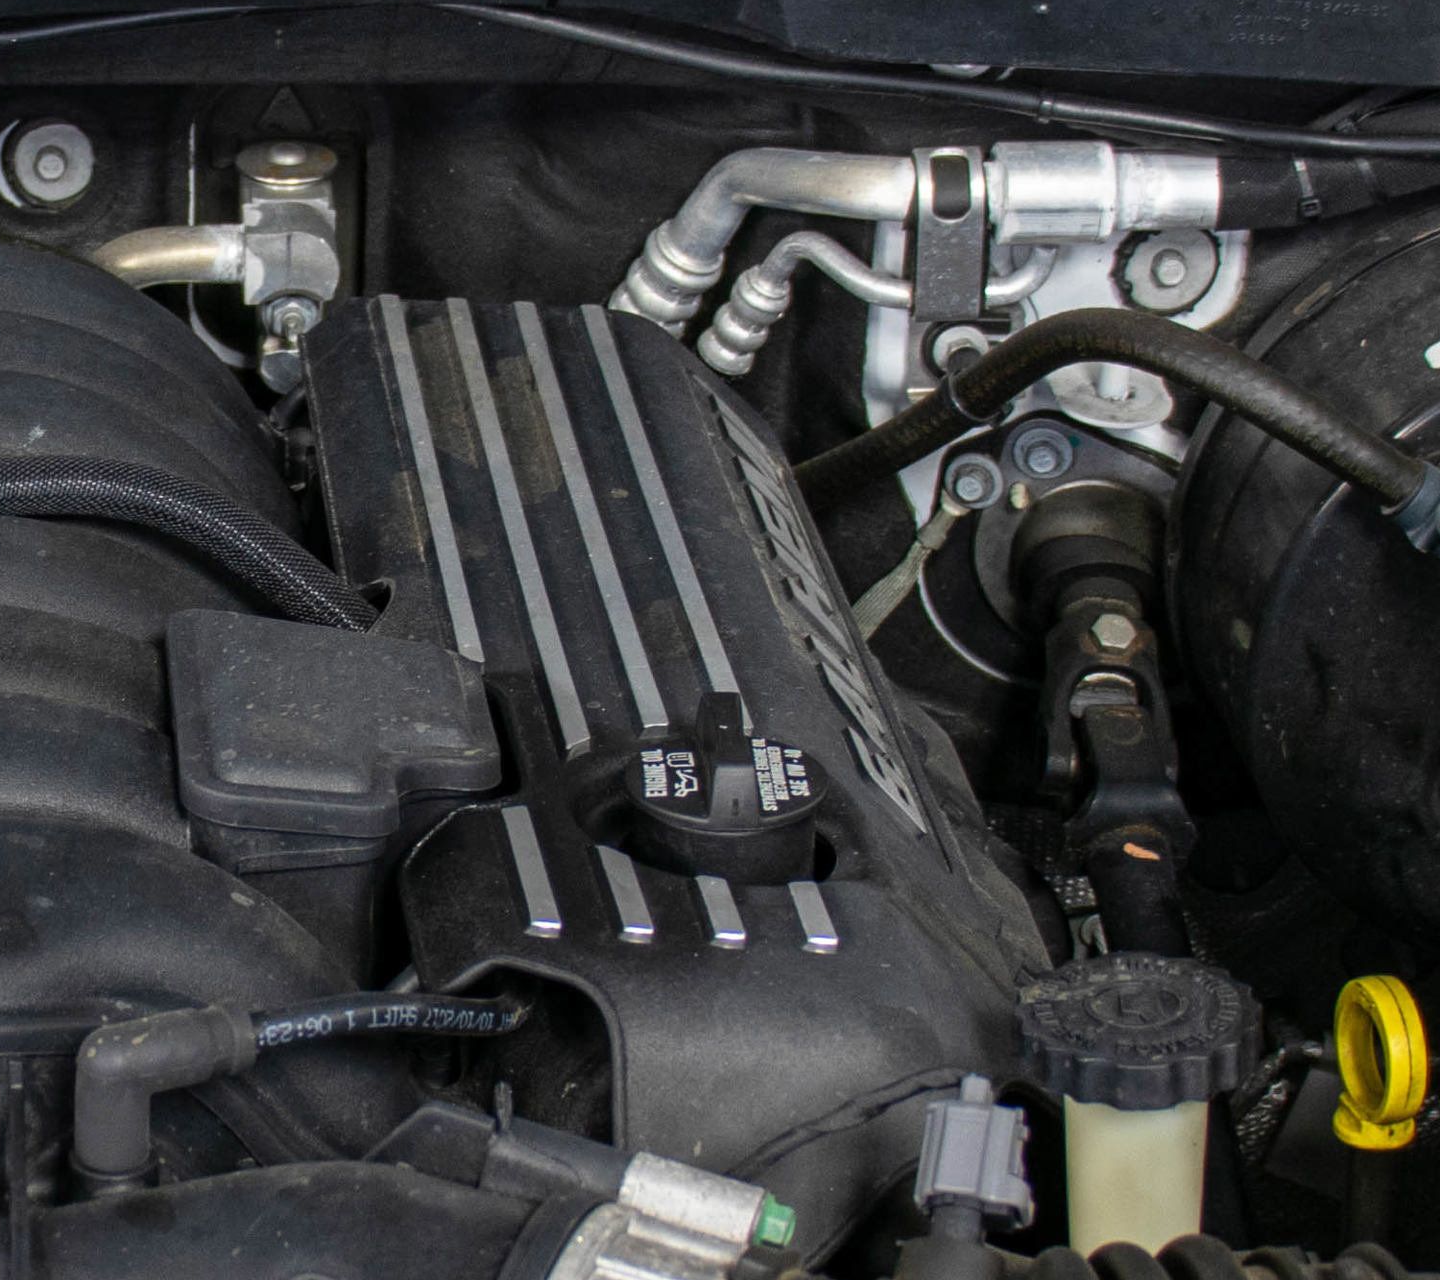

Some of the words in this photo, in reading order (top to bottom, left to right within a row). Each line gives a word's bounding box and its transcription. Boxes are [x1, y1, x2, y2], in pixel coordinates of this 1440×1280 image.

[640, 748, 664, 763] OIL
[643, 763, 668, 798] ENGINE
[789, 778, 811, 797] SAE
[367, 1004, 418, 1029] SHIFT
